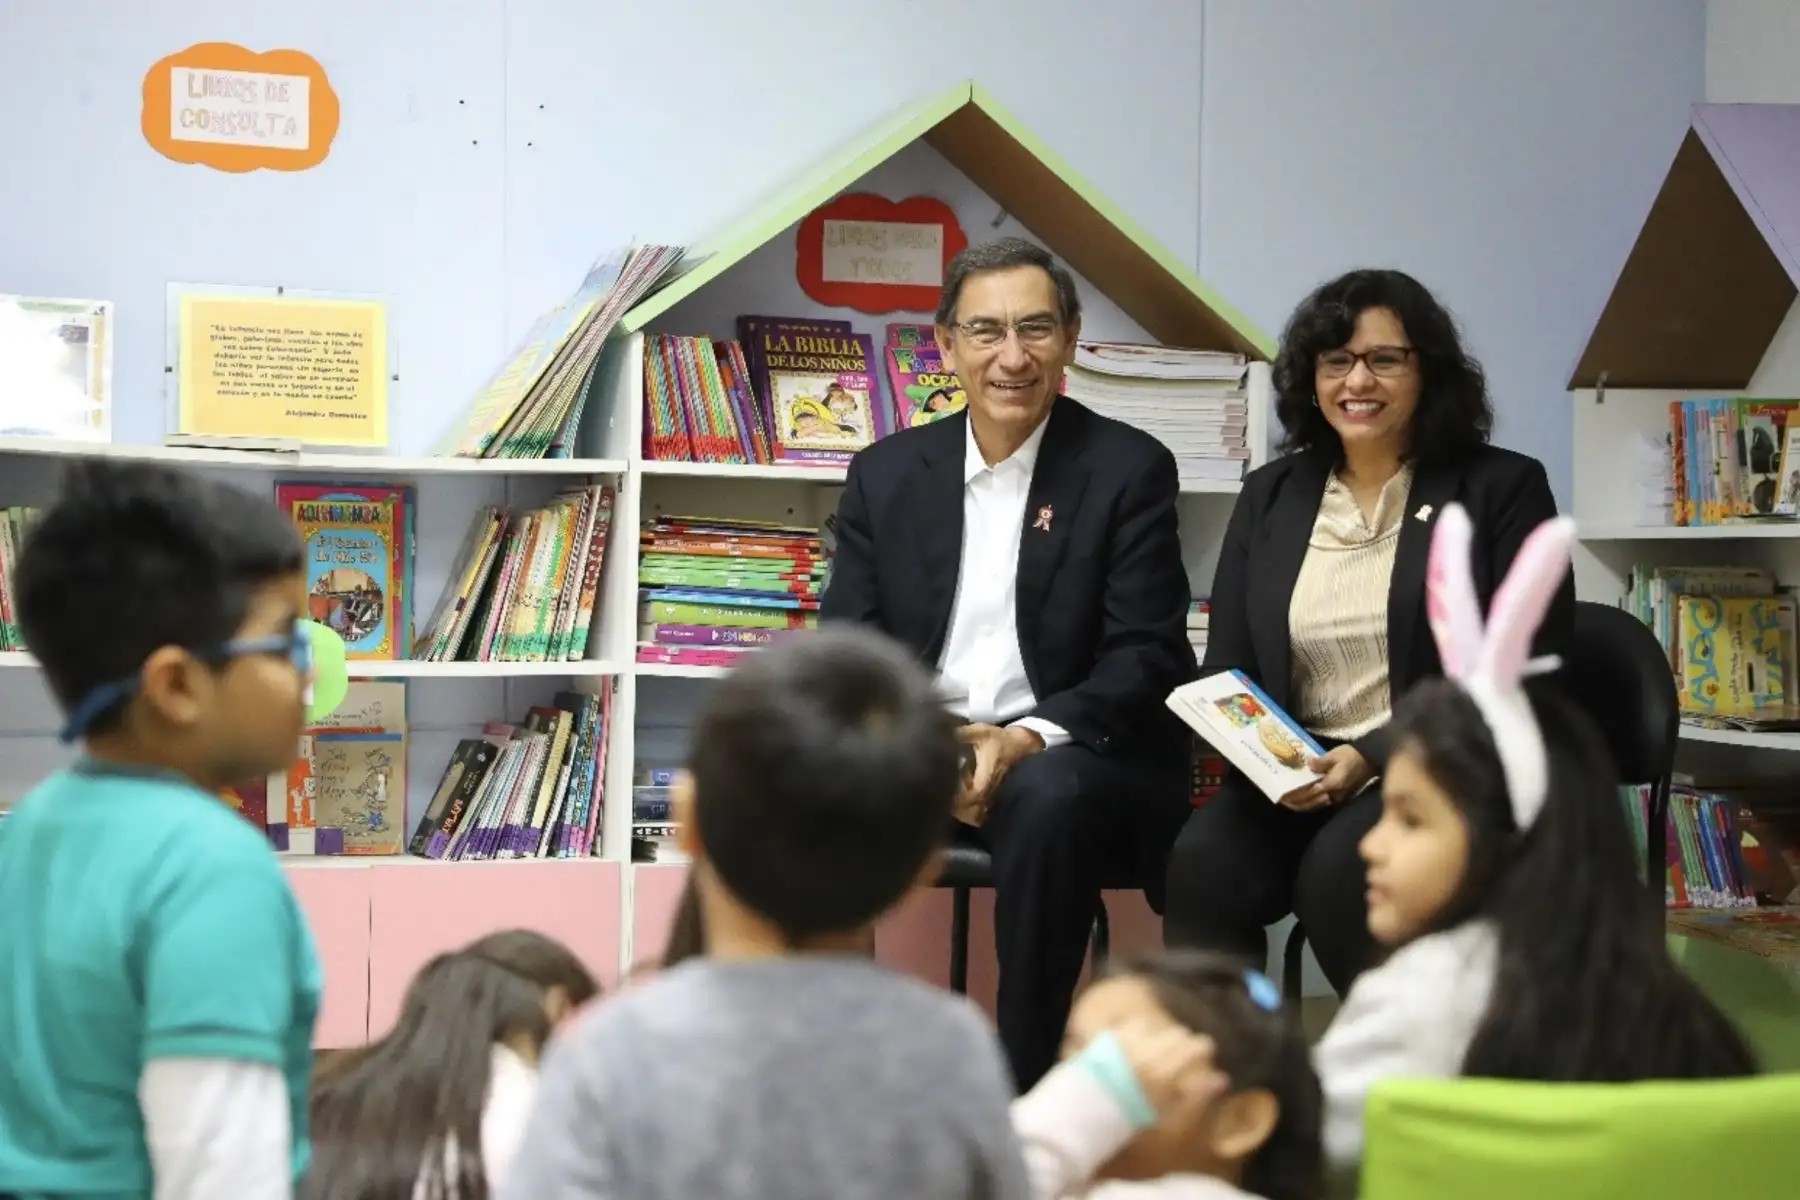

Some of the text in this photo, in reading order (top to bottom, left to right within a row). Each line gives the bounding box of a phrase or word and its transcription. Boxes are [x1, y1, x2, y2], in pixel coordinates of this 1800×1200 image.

[188, 73, 291, 105] LIBROS DE
[179, 107, 297, 138] CONSULTA
[765, 334, 865, 357] LA BIBLIA
[766, 354, 866, 371] DE LOS NIÑOS
[917, 373, 961, 387] OCEA
